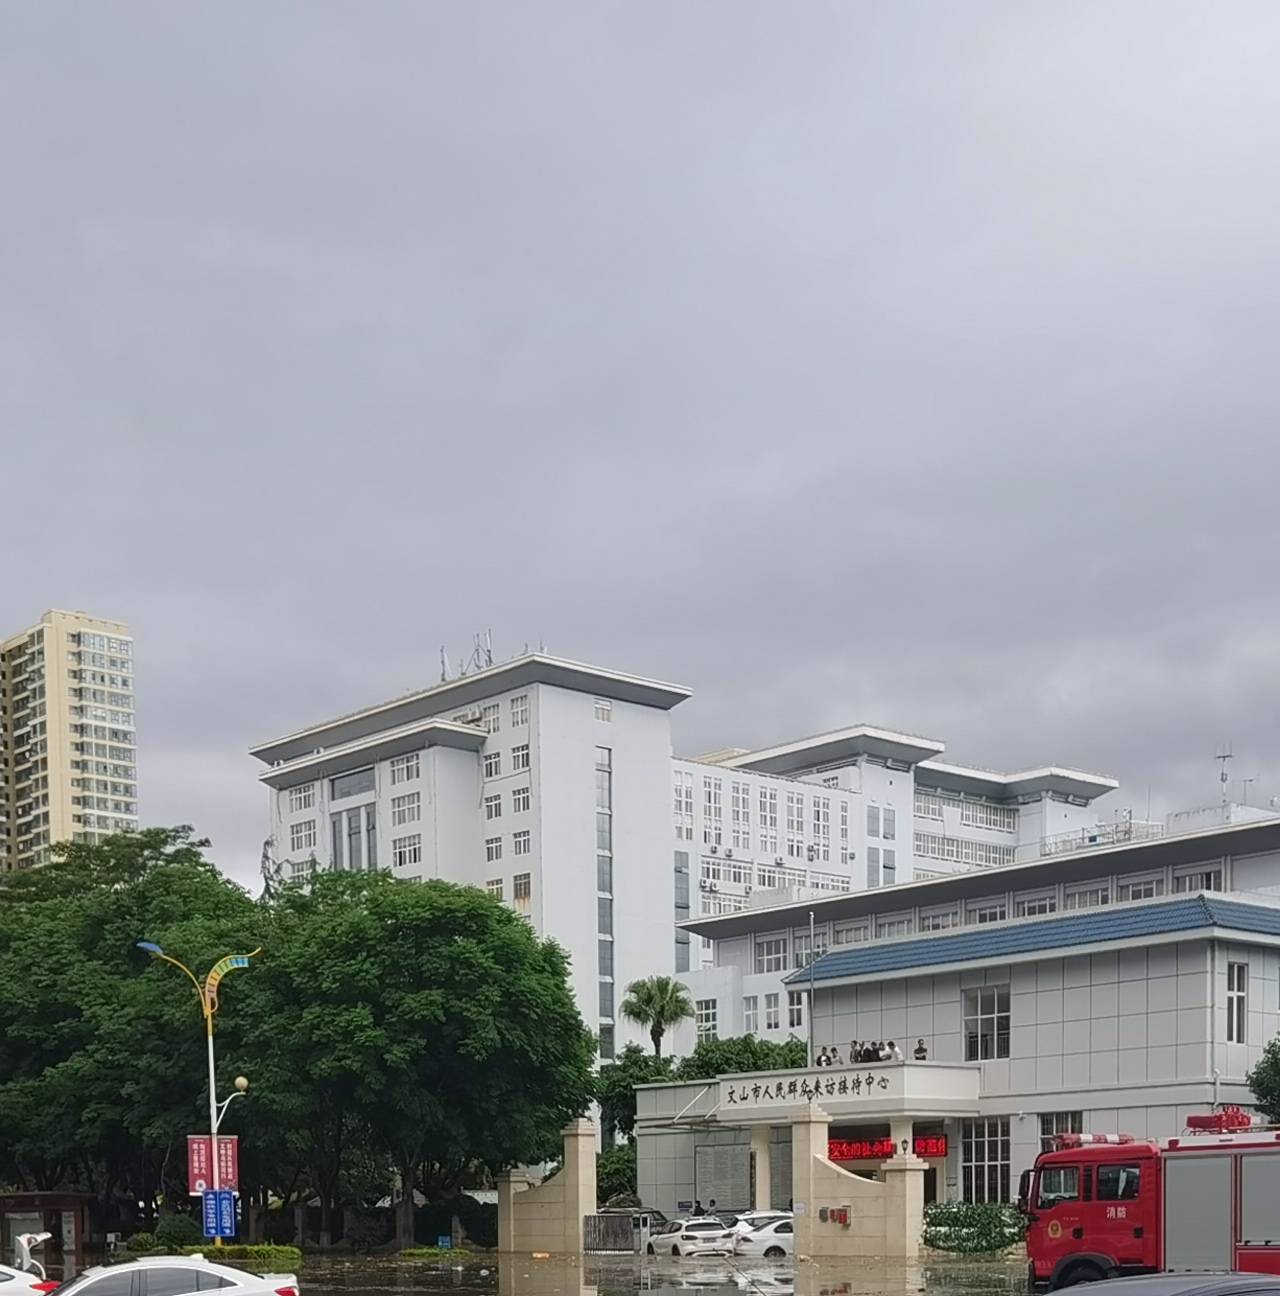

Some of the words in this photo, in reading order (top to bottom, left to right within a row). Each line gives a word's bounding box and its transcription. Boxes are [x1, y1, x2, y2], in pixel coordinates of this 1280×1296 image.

[727, 1072, 890, 1104] 文山市人民群众来访接待中心
[1106, 1206, 1127, 1219] 消防
